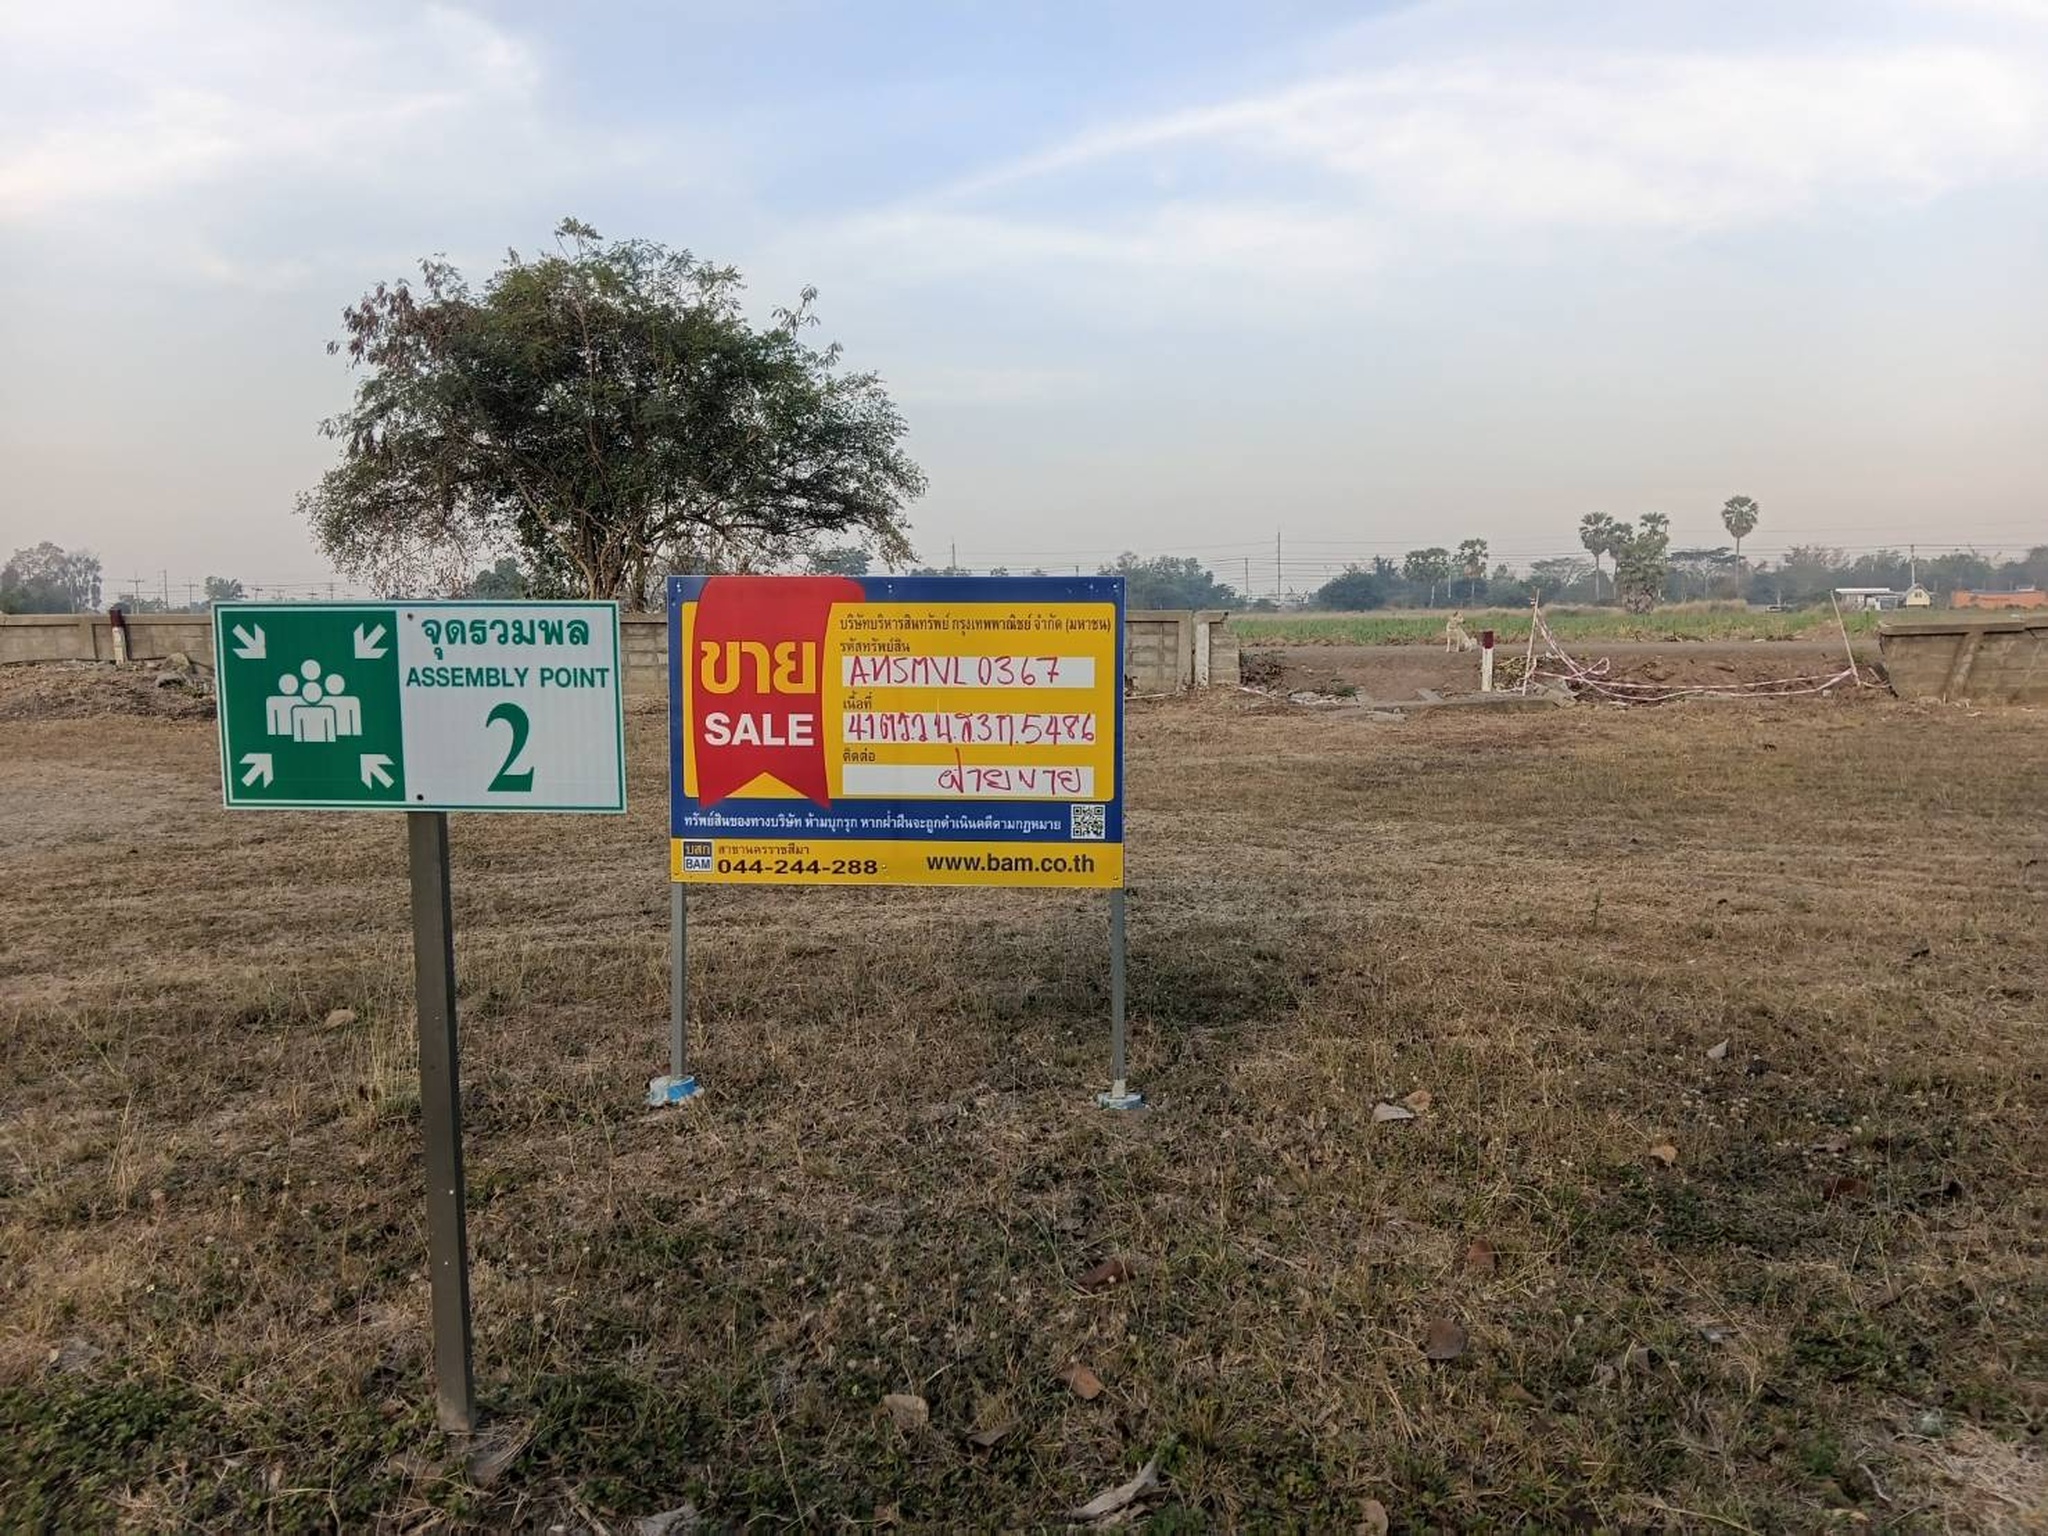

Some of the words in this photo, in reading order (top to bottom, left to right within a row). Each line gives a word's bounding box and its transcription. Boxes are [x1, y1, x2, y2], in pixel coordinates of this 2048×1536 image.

[840, 613, 950, 631] บริษัทบริหารสินทรัพย์
[951, 613, 1032, 636] กรุงเทพพาณิชย์
[1034, 613, 1062, 631] จำกัด
[1065, 618, 1111, 633] (มหาชน)
[421, 618, 590, 661] จุดรวมพล
[840, 638, 911, 653] รหัสทรัพย์สิน
[406, 667, 528, 689] ASSEMBLY
[540, 668, 610, 689] POINT
[701, 641, 817, 694] ขาย
[978, 655, 1060, 686] 0367
[843, 691, 873, 710] เนื้อที่
[704, 712, 815, 746] SALE
[486, 703, 535, 793] 2
[842, 748, 876, 763] ติดต่อ
[684, 811, 802, 829] ทรัพย์สินของทางบริษัท
[805, 812, 858, 832] ห้ามบุกรุก
[718, 843, 810, 855] สาขานครราชสีมา
[686, 858, 711, 870] BAM
[718, 859, 878, 875] 044-244-288
[927, 853, 1095, 873] www.bam.co.th
